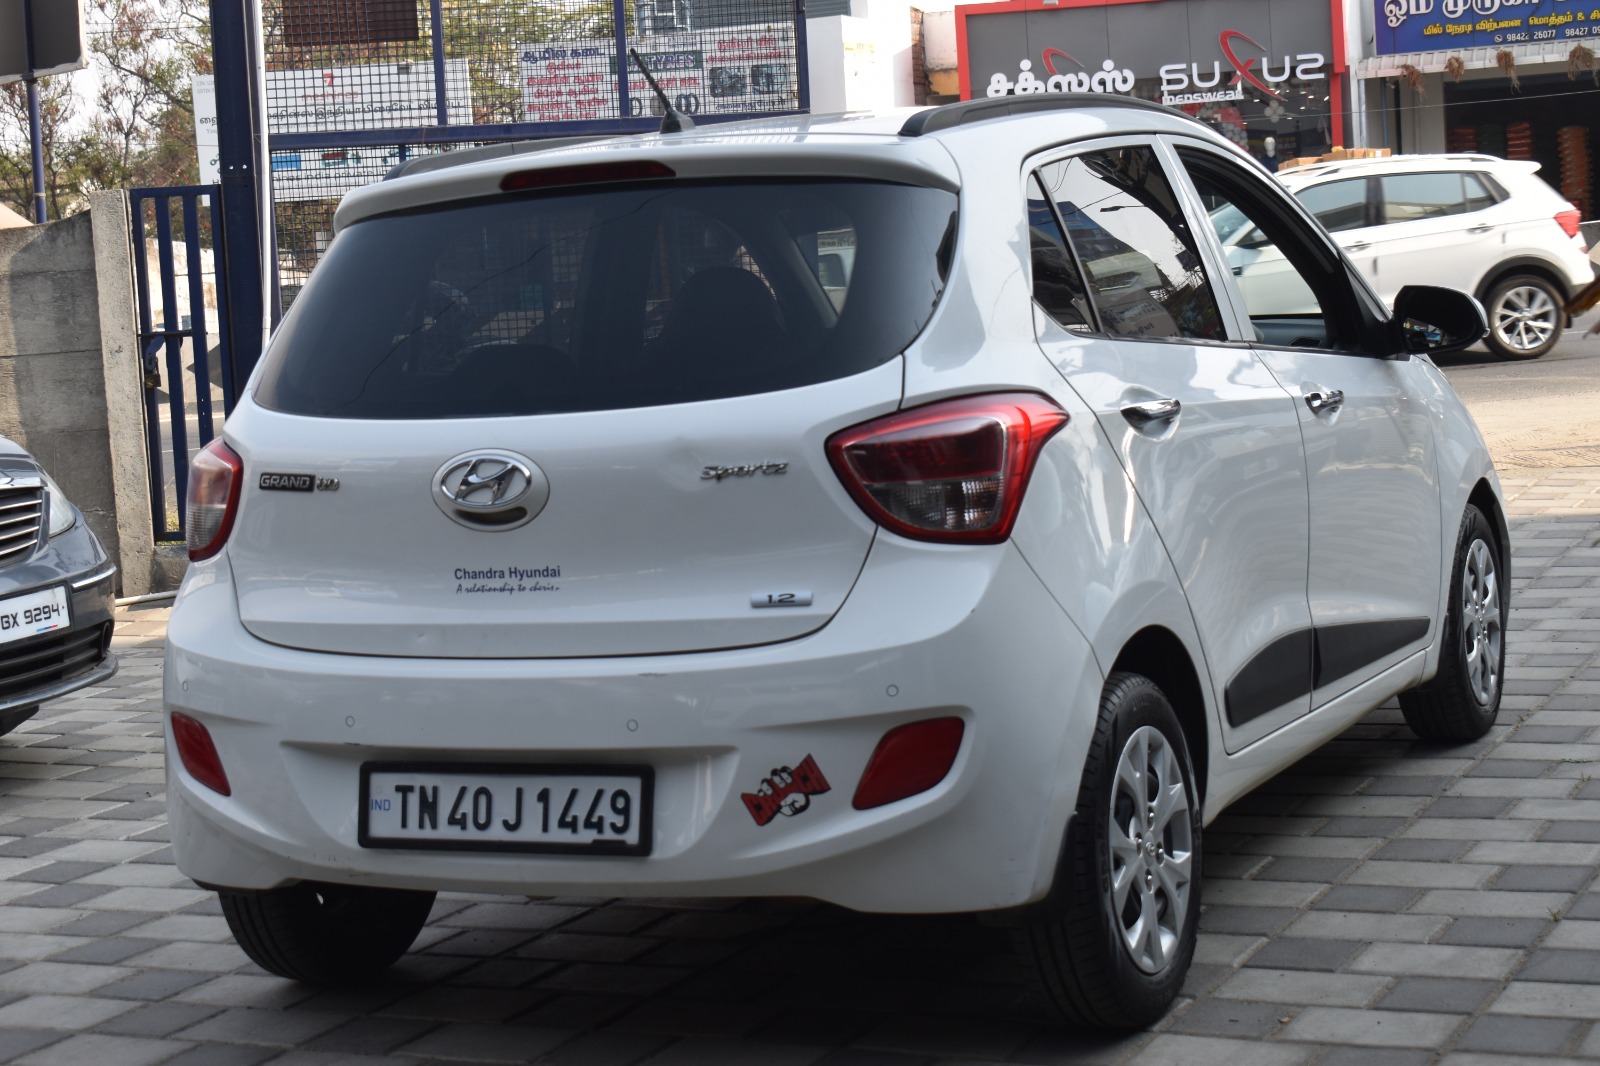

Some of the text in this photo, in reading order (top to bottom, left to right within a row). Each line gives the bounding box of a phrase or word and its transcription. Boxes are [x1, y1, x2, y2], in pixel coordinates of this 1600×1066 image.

[1533, 29, 1556, 39] 26077
[1565, 27, 1588, 37] 98427
[645, 52, 696, 71] TYRES
[701, 461, 789, 482] Sportz
[260, 475, 310, 488] GRAND
[454, 565, 561, 581] Chandra Hyundai
[456, 583, 463, 594] A
[465, 582, 516, 595] relationship
[518, 584, 527, 592] to
[24, 603, 61, 625] 9294
[371, 799, 391, 811] IND
[536, 787, 632, 834] 1449
